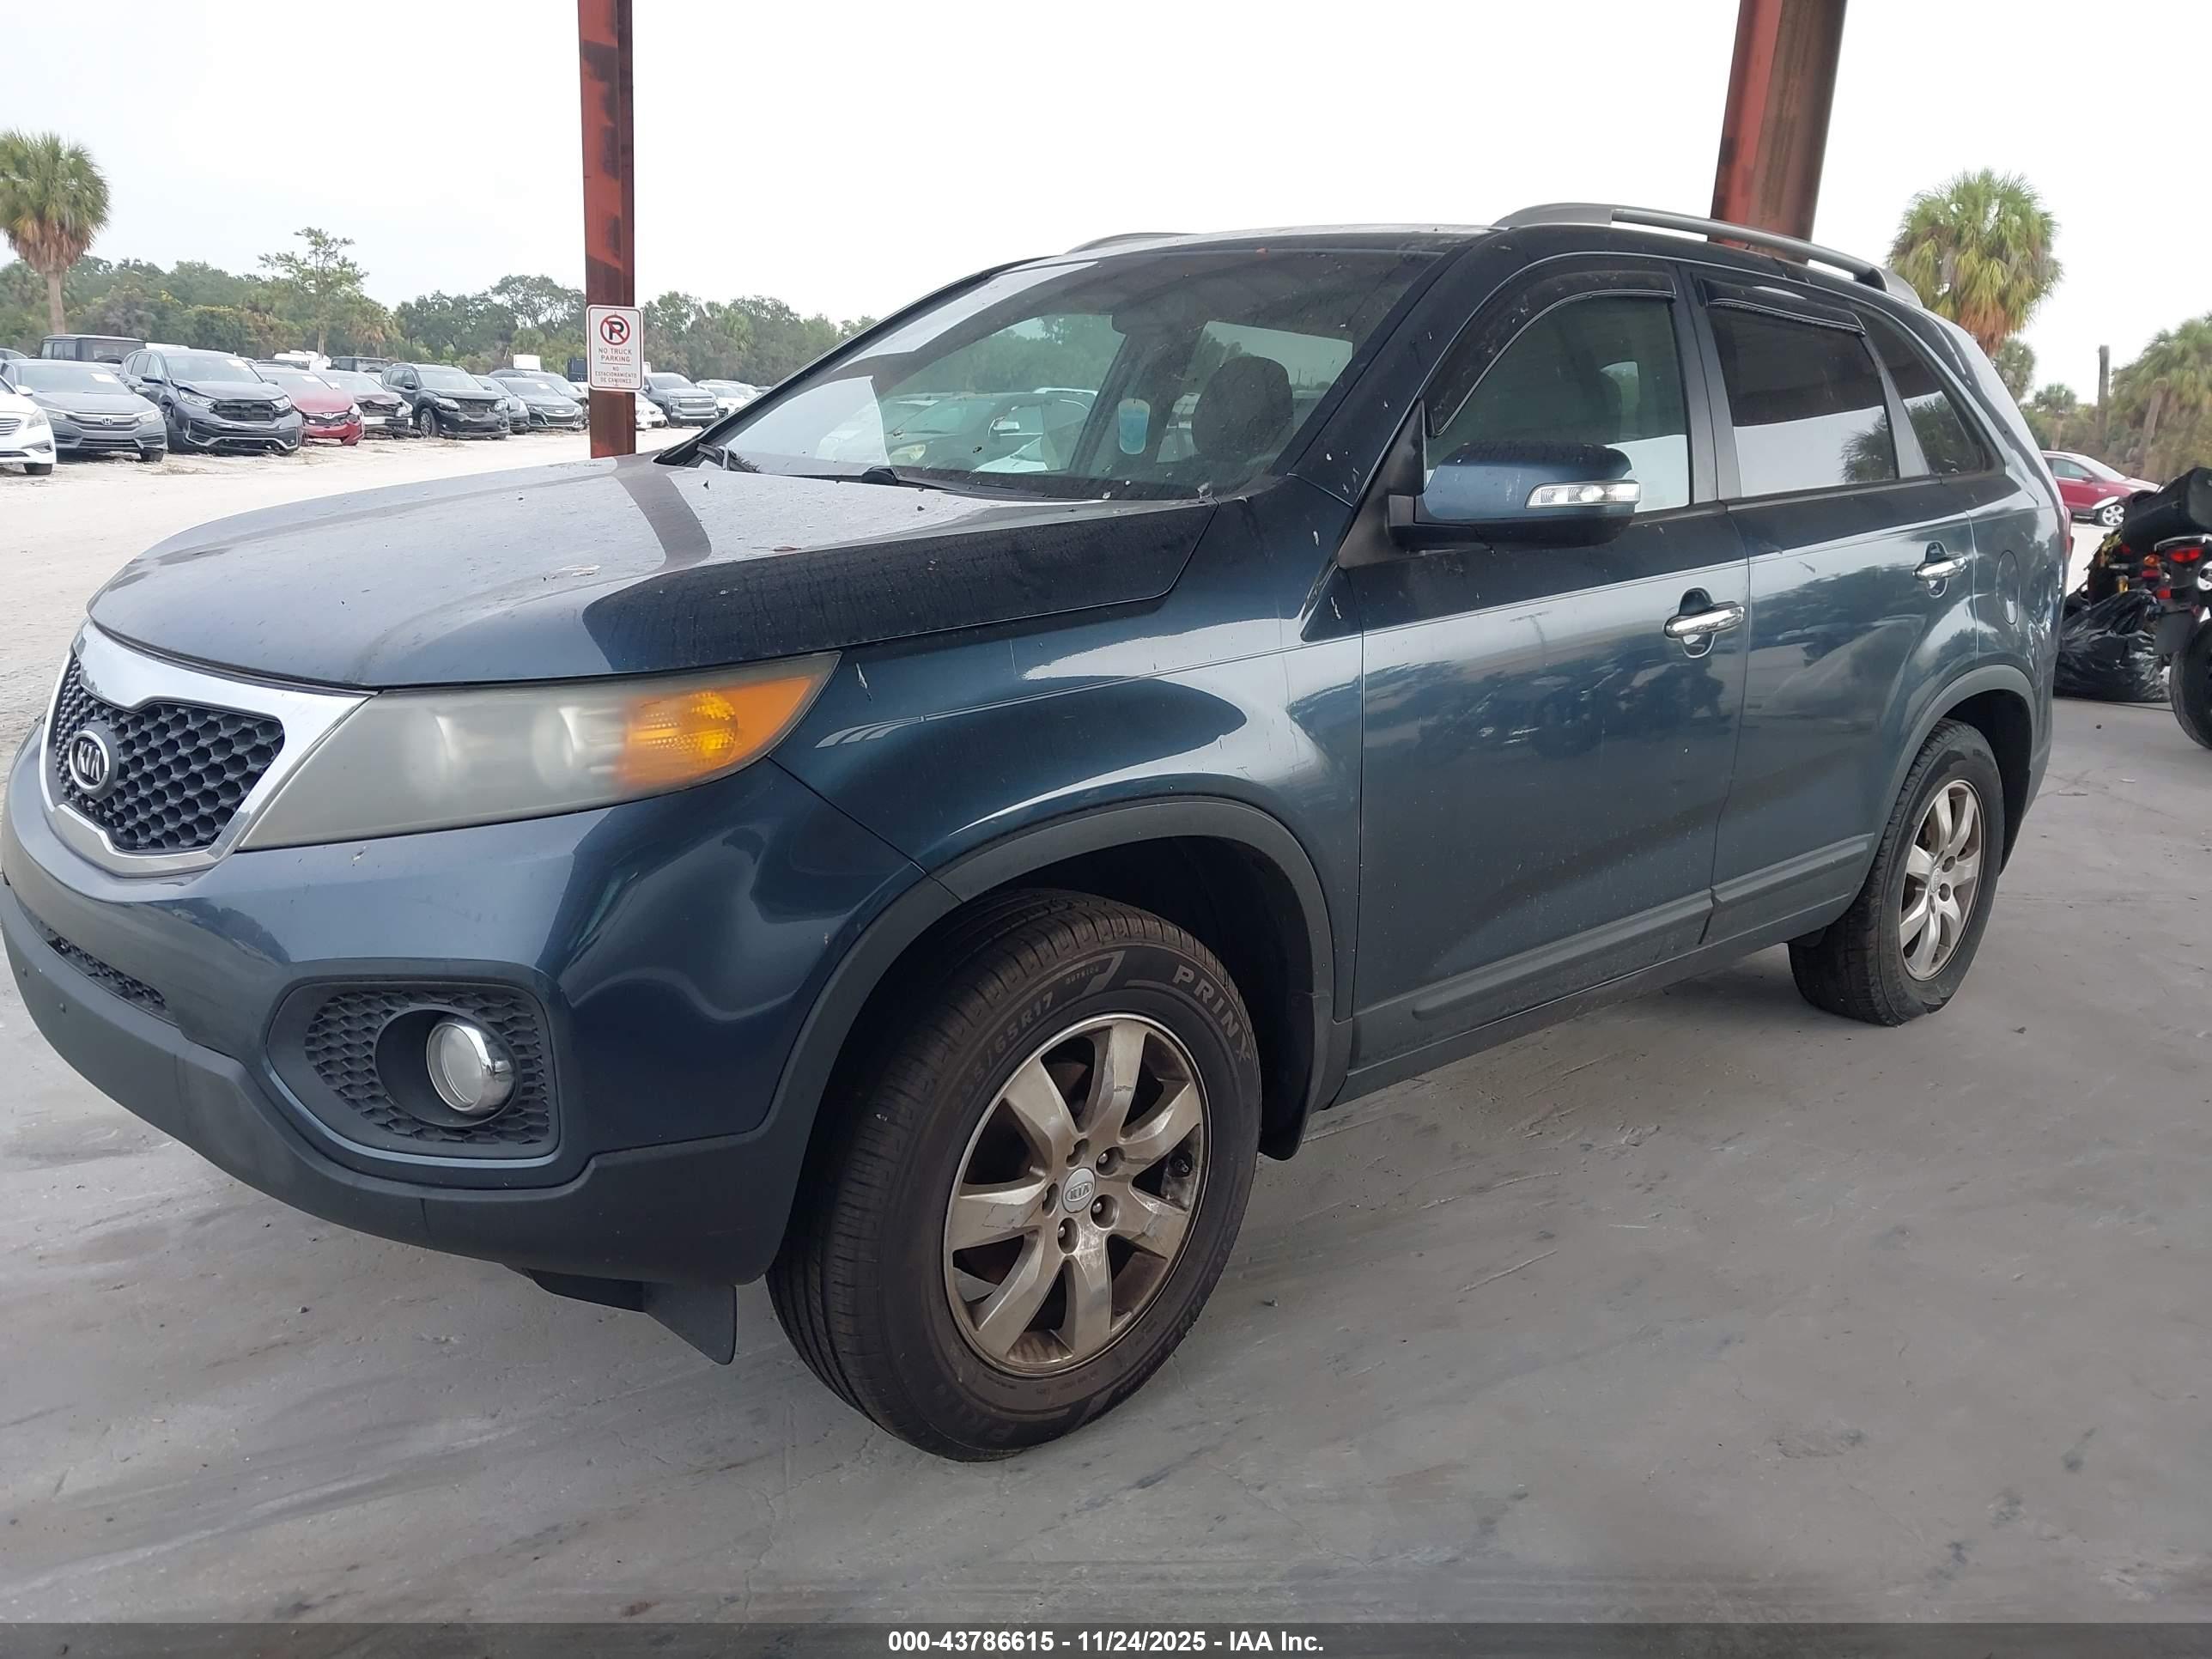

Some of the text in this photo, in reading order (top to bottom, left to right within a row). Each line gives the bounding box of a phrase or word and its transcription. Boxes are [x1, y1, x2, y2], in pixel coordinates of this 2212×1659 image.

[76, 740, 101, 782] KIA
[1171, 963, 1251, 1063] PRINX
[1069, 1184, 1091, 1200] KIA
